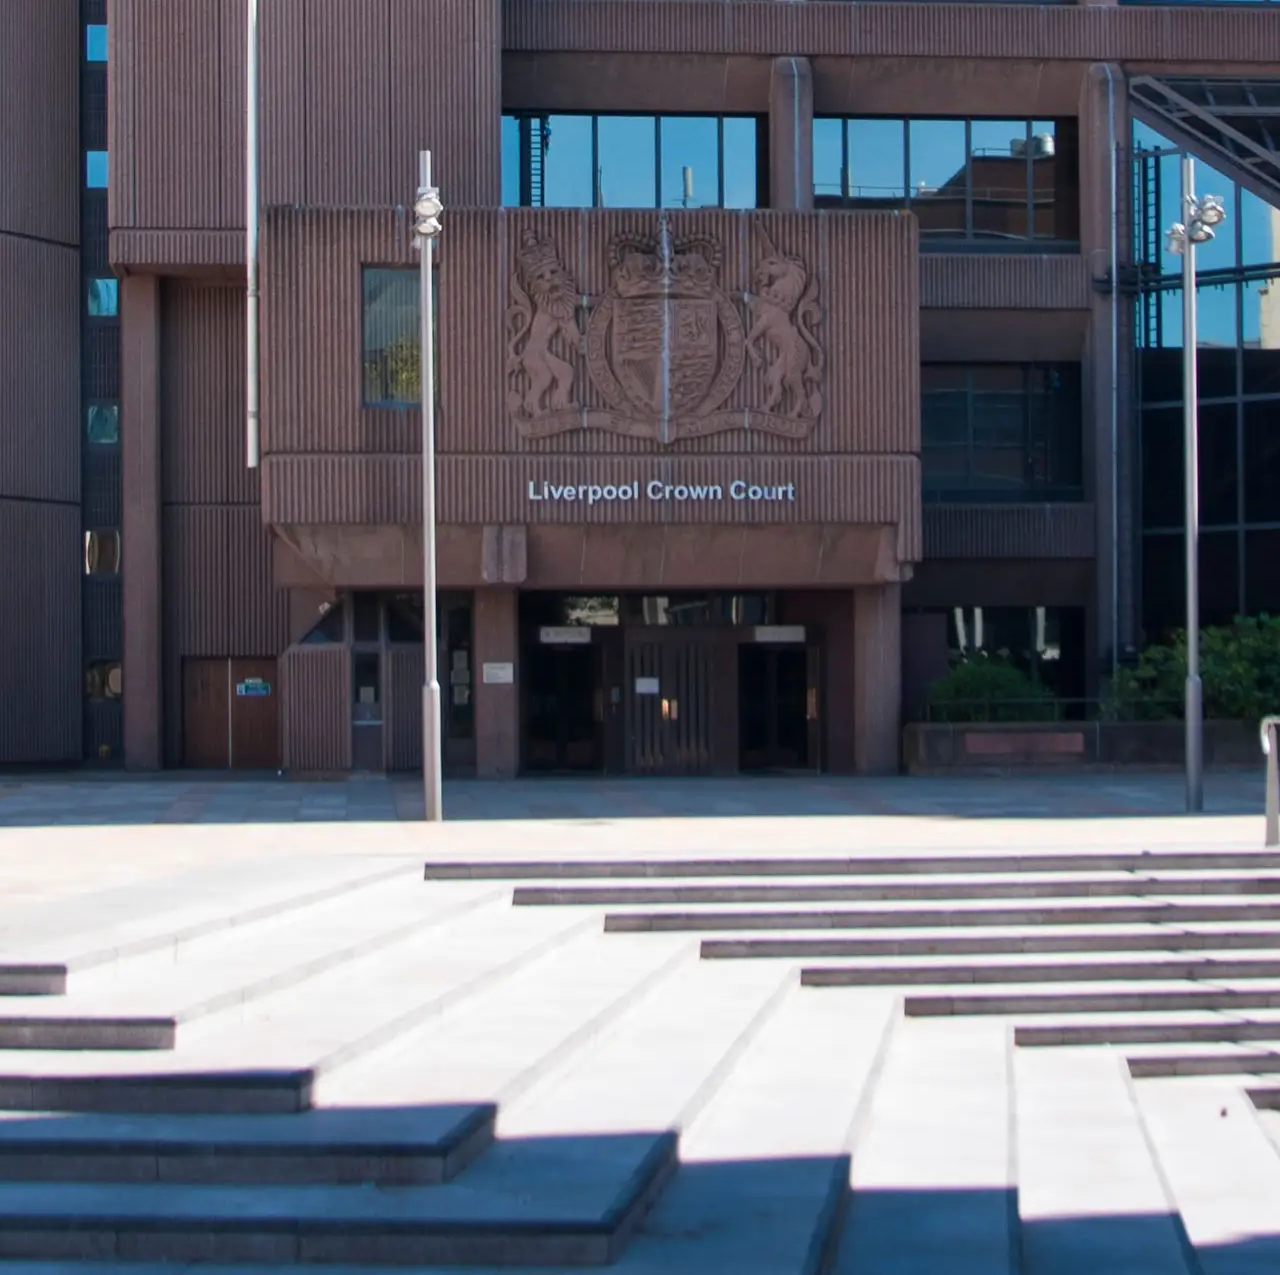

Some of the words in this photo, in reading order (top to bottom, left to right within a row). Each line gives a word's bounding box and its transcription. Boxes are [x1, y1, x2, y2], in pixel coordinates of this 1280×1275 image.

[528, 480, 639, 505] Liverpool
[646, 480, 723, 501] Crown
[729, 480, 795, 501] Court
